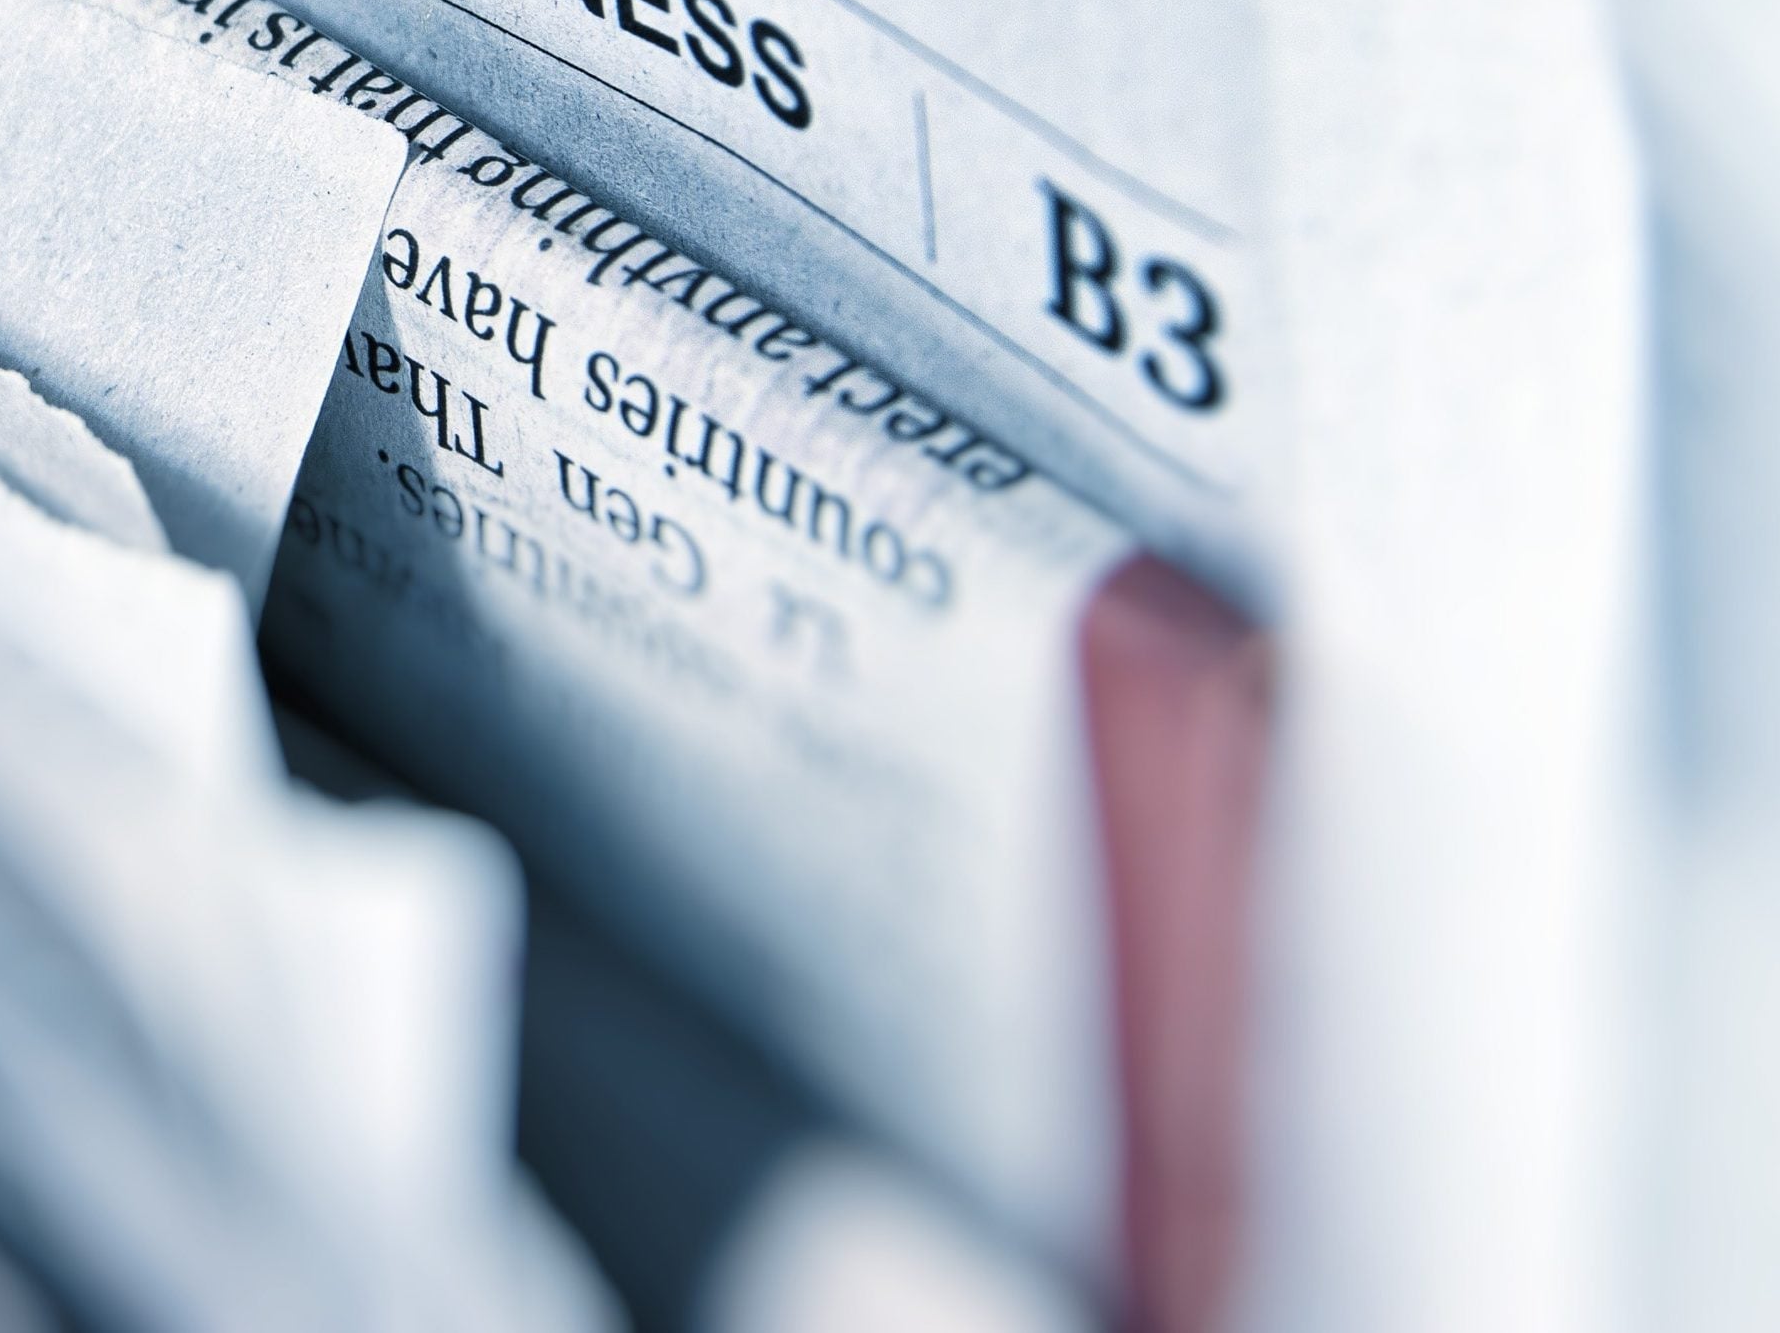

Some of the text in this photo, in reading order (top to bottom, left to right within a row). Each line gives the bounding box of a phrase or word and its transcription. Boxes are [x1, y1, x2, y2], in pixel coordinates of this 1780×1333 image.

[380, 227, 557, 399] have
[459, 150, 815, 360] anything
[1034, 173, 1226, 414] B3
[556, 448, 707, 596] Gen
[584, 350, 953, 611] countries
